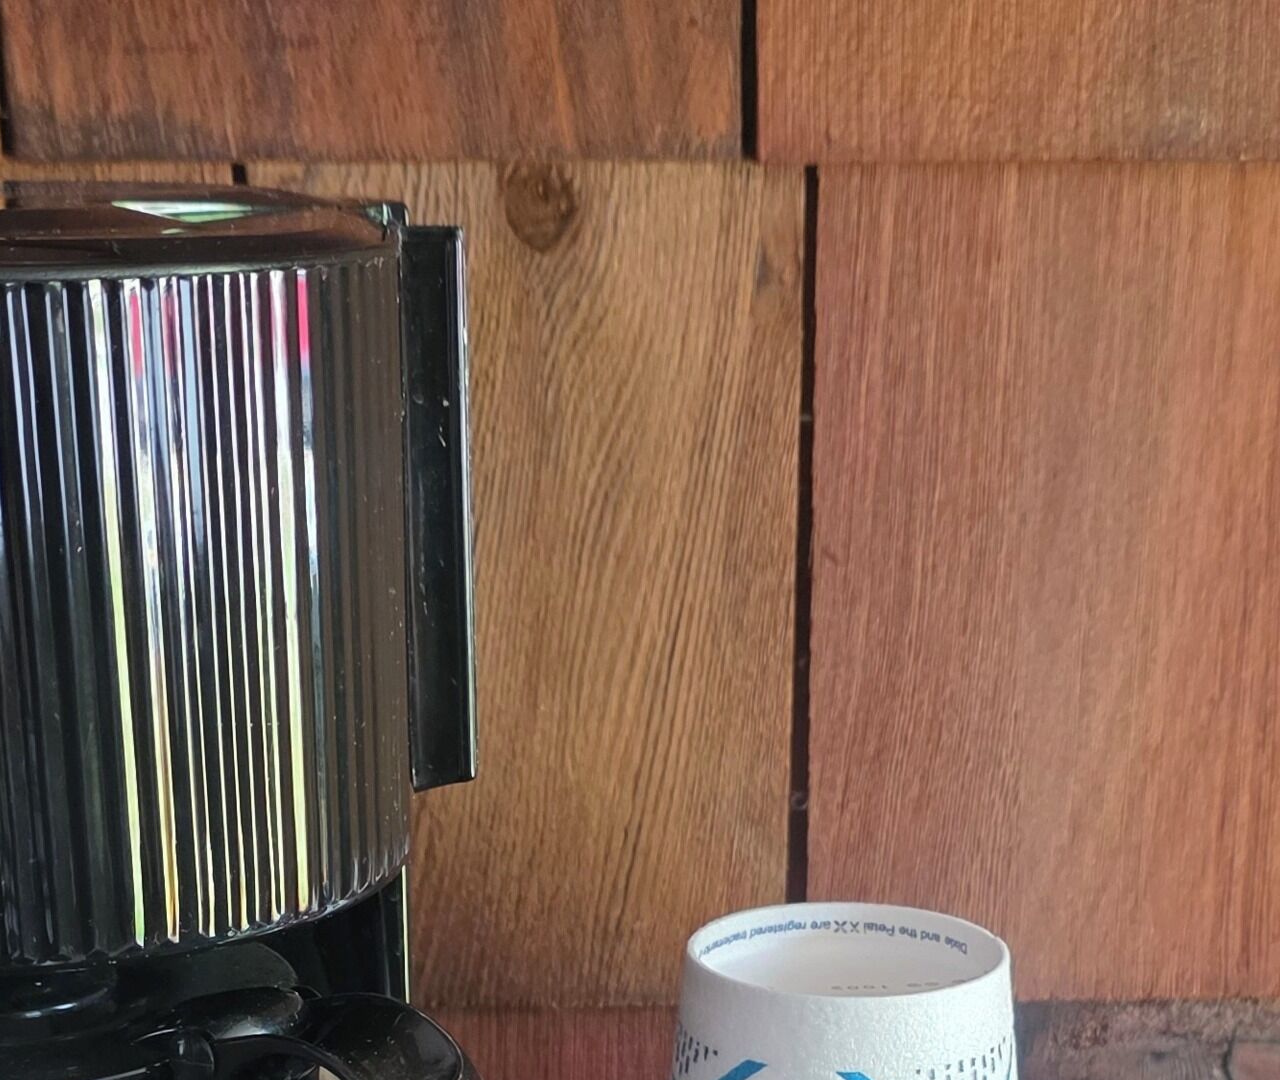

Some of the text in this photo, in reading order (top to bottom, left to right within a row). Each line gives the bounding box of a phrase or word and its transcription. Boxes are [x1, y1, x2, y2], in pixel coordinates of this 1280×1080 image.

[749, 919, 807, 940] registered
[810, 920, 831, 930] are
[898, 926, 918, 939] the
[920, 930, 941, 943] and
